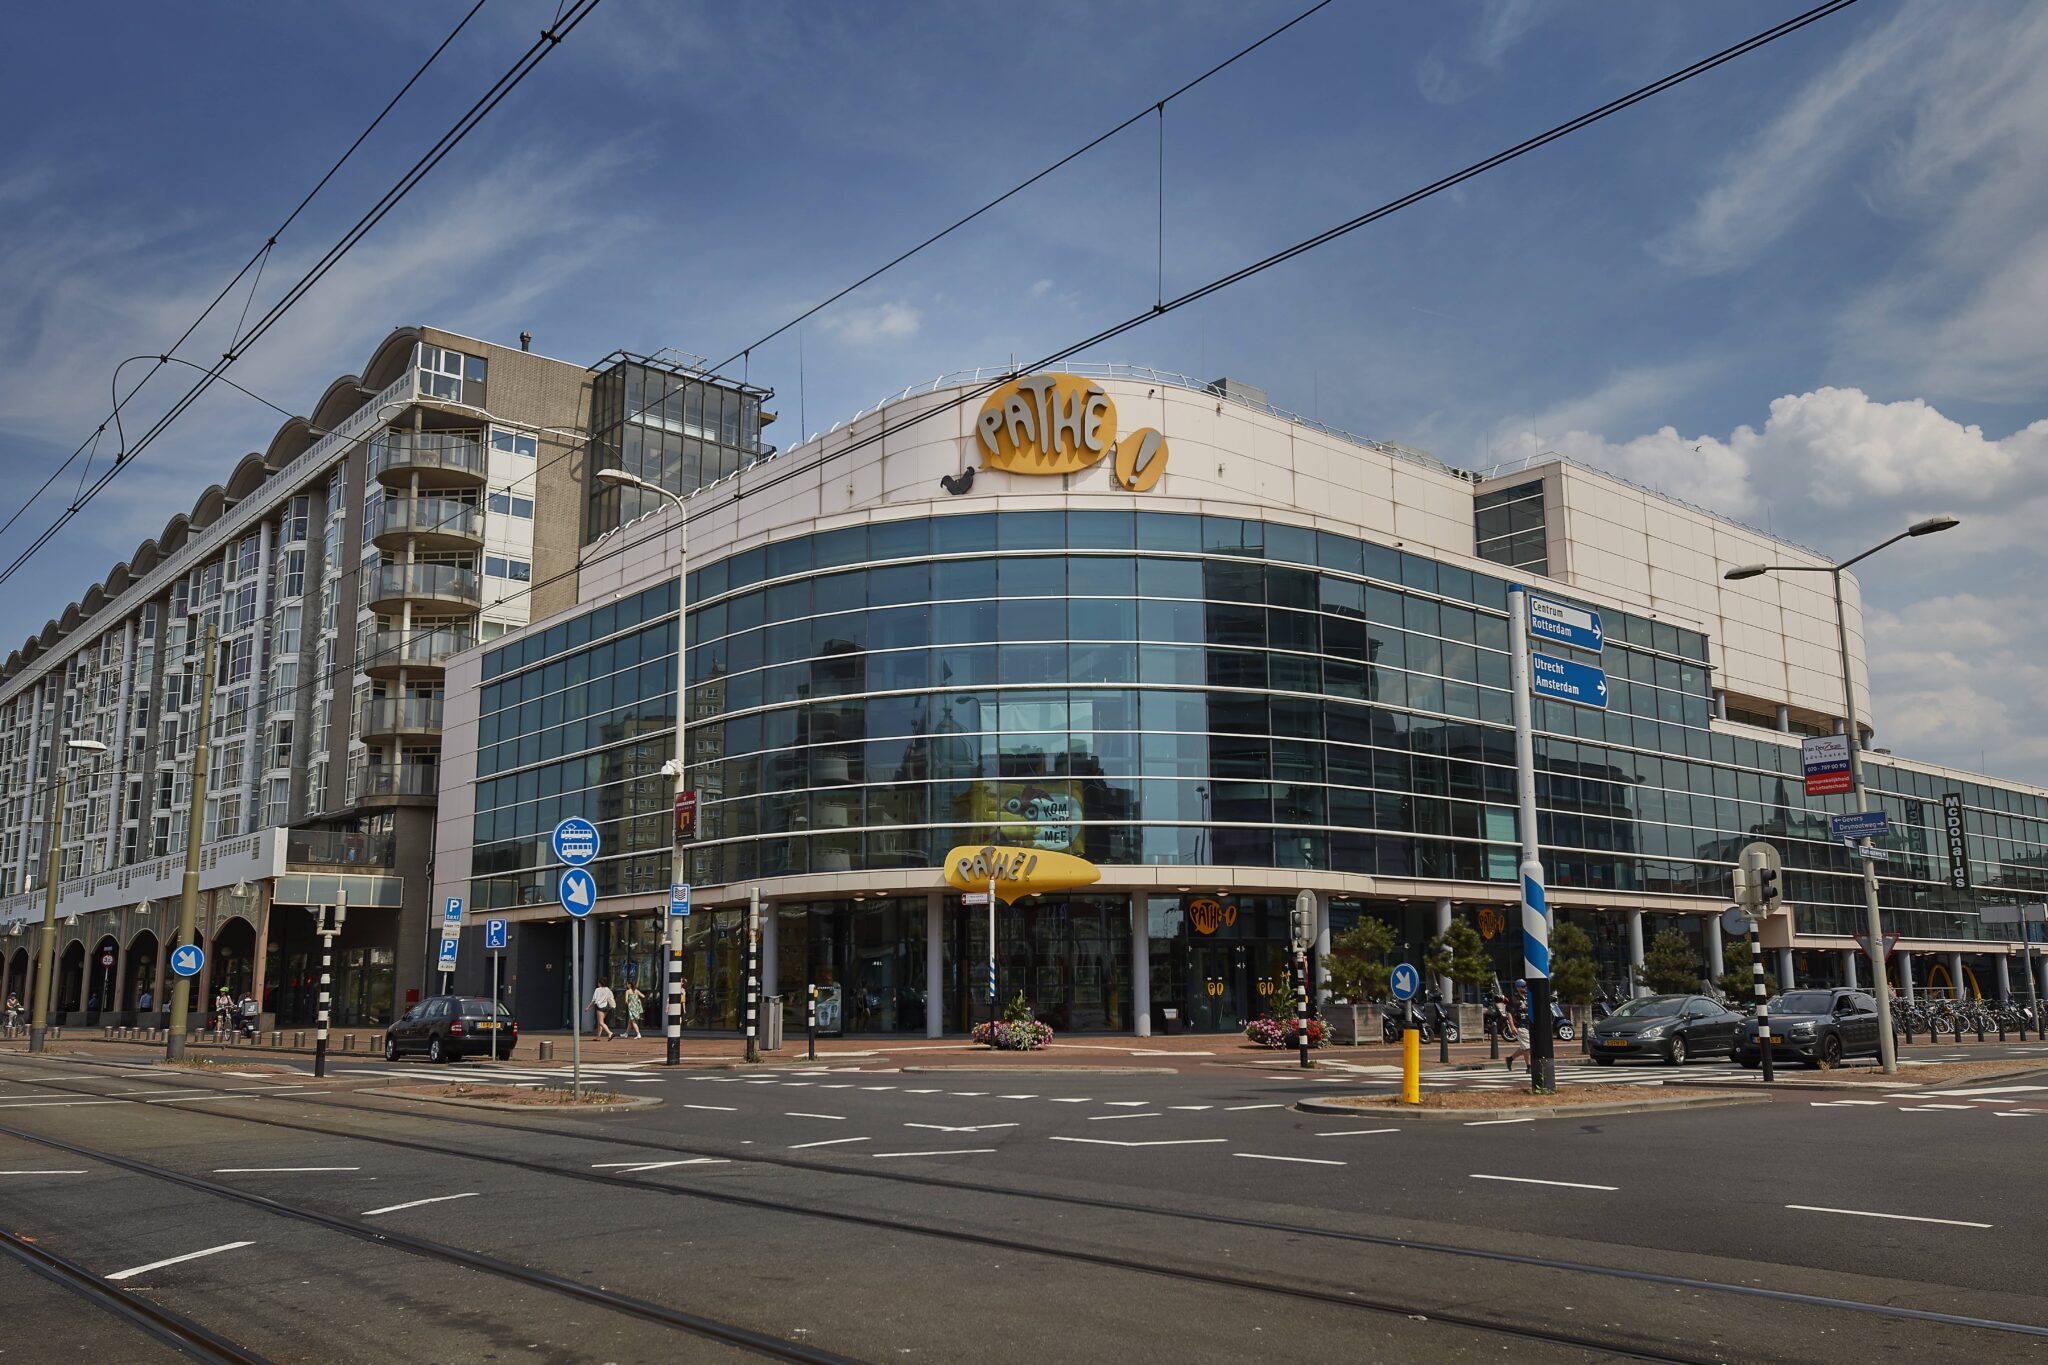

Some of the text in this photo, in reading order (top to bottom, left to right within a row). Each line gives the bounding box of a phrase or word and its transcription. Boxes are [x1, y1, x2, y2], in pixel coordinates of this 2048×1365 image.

[1533, 601, 1563, 617] Centrum
[1532, 617, 1572, 636] Rotterdam
[1535, 658, 1564, 674] Utrecht
[1536, 676, 1579, 694] Amsterdam
[1043, 802, 1067, 818] KOM
[1044, 830, 1067, 844] MEE
